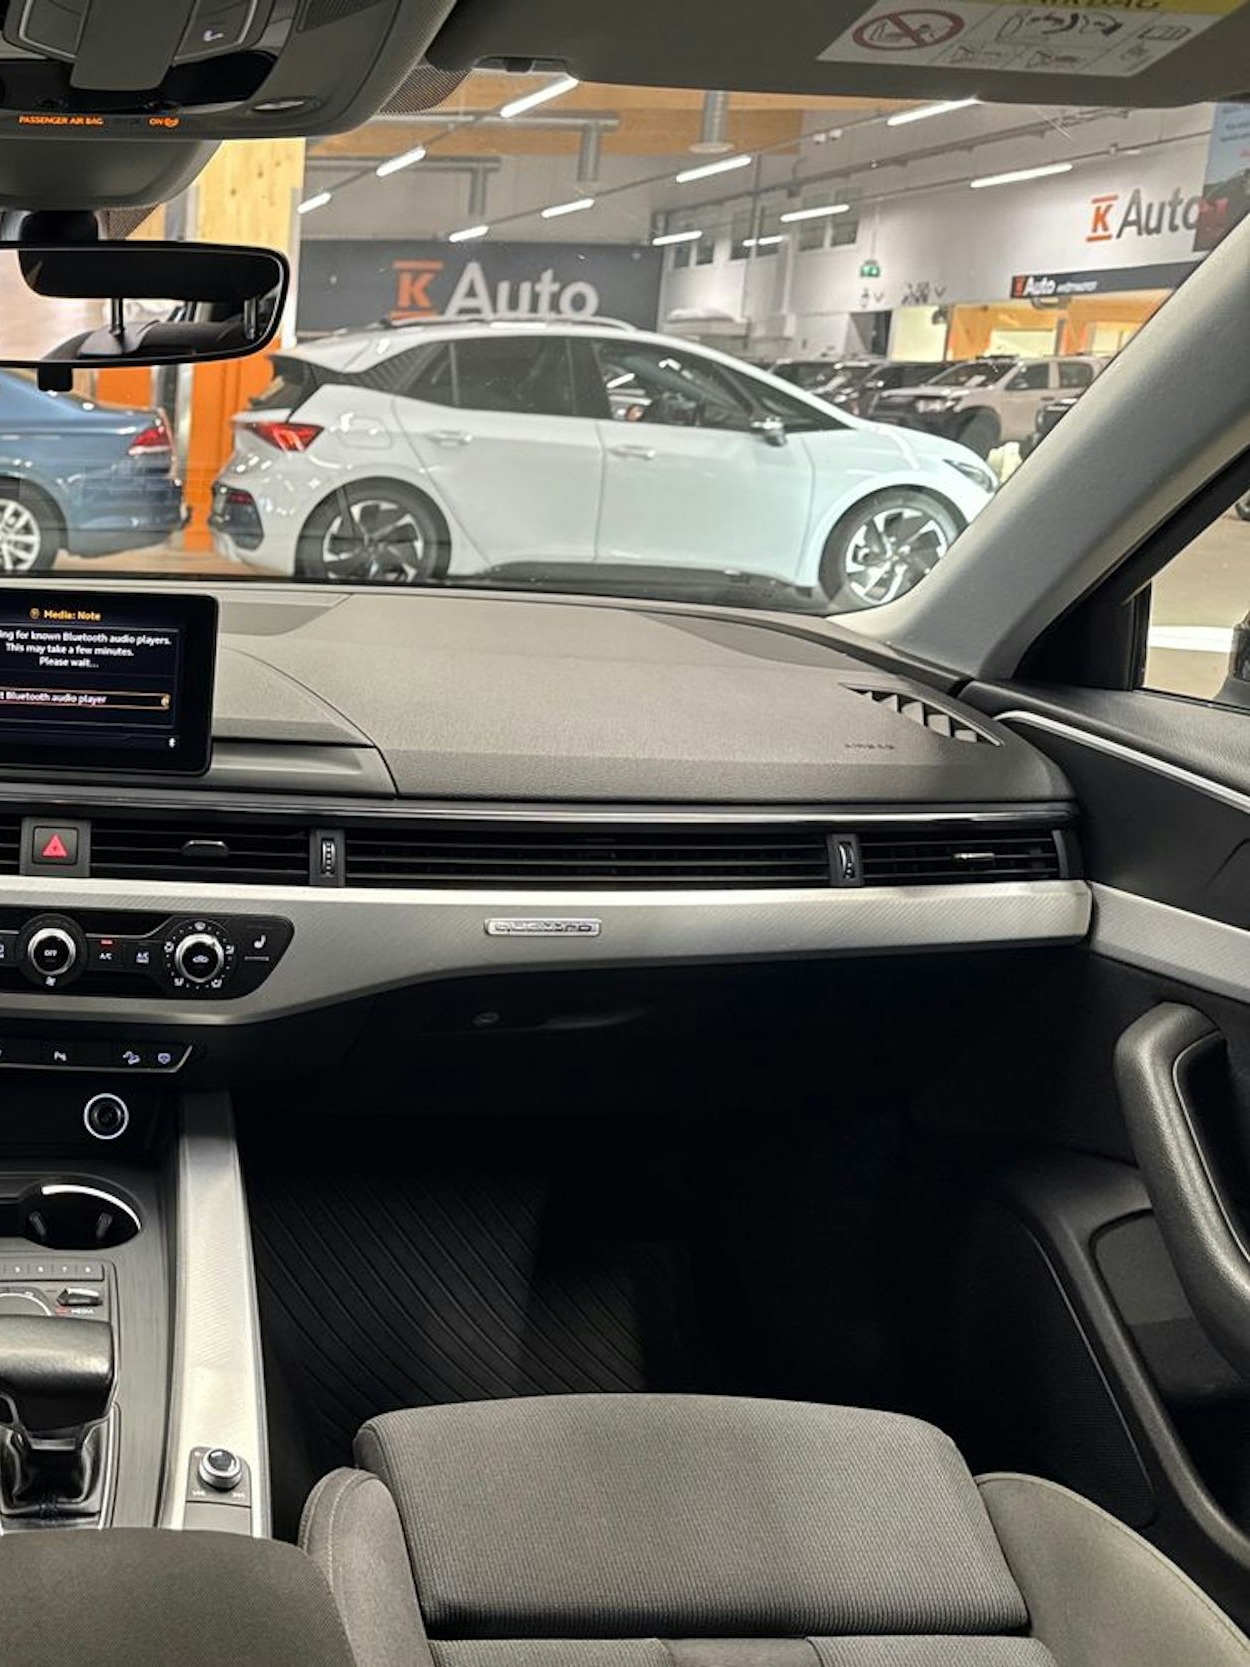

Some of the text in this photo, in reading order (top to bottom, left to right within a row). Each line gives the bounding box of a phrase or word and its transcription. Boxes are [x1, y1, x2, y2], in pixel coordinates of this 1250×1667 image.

[19, 116, 104, 126] PASSENGER AIR BAG
[149, 117, 163, 126] ON
[445, 260, 599, 319] Auto
[44, 610, 101, 621] Media: Note
[15, 629, 29, 640] for
[31, 630, 61, 641] known
[63, 632, 108, 643] Bluetooth
[109, 634, 135, 644] audio
[136, 635, 171, 646] players.
[6, 642, 24, 652] This
[26, 645, 45, 655] may
[47, 645, 67, 654] take
[75, 645, 93, 655] few
[94, 646, 134, 656] minutes.
[39, 656, 69, 667] Please
[6, 691, 50, 702] Bluetooth
[51, 694, 77, 703] audio
[78, 695, 107, 705] player
[44, 949, 58, 957] OFF
[99, 952, 113, 961] A/C
